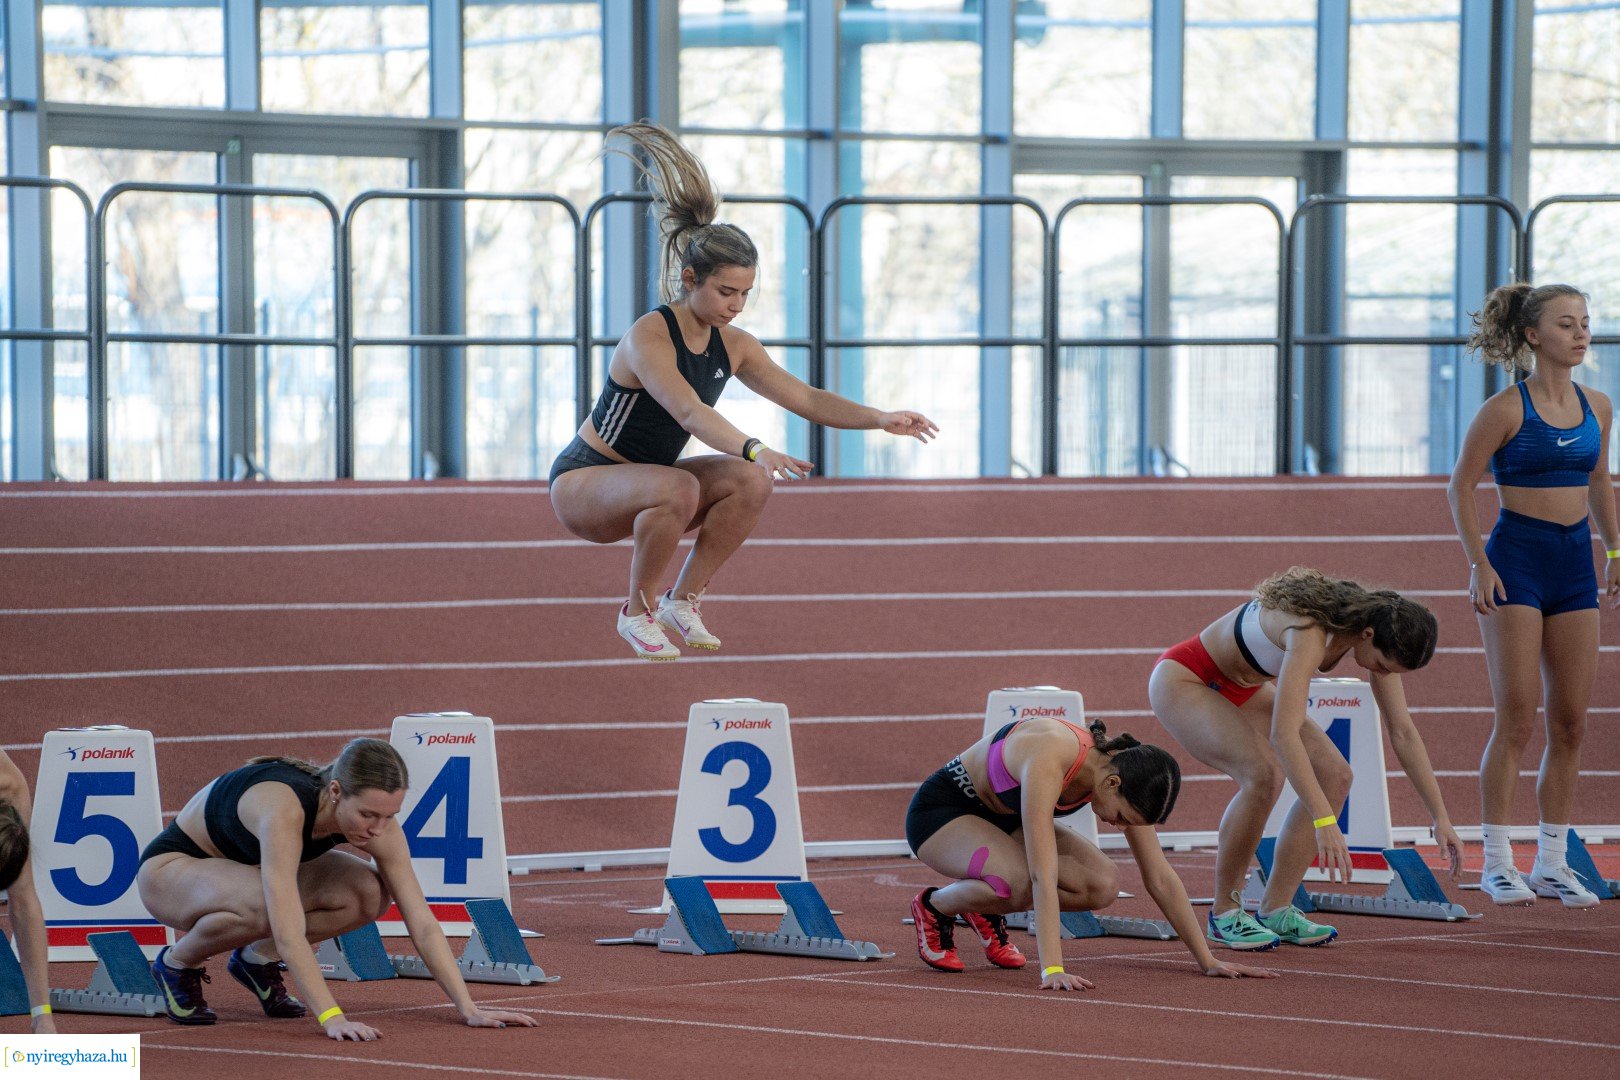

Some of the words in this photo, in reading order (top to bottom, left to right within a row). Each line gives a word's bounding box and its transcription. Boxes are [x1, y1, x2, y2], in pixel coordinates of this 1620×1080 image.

[1318, 697, 1361, 708] polanik
[1021, 706, 1066, 718] polanik
[724, 718, 772, 731] polanik
[427, 733, 477, 746] polanik
[81, 747, 135, 761] polanik
[698, 741, 777, 863] 3
[401, 756, 483, 884] 4
[49, 771, 140, 906] 5
